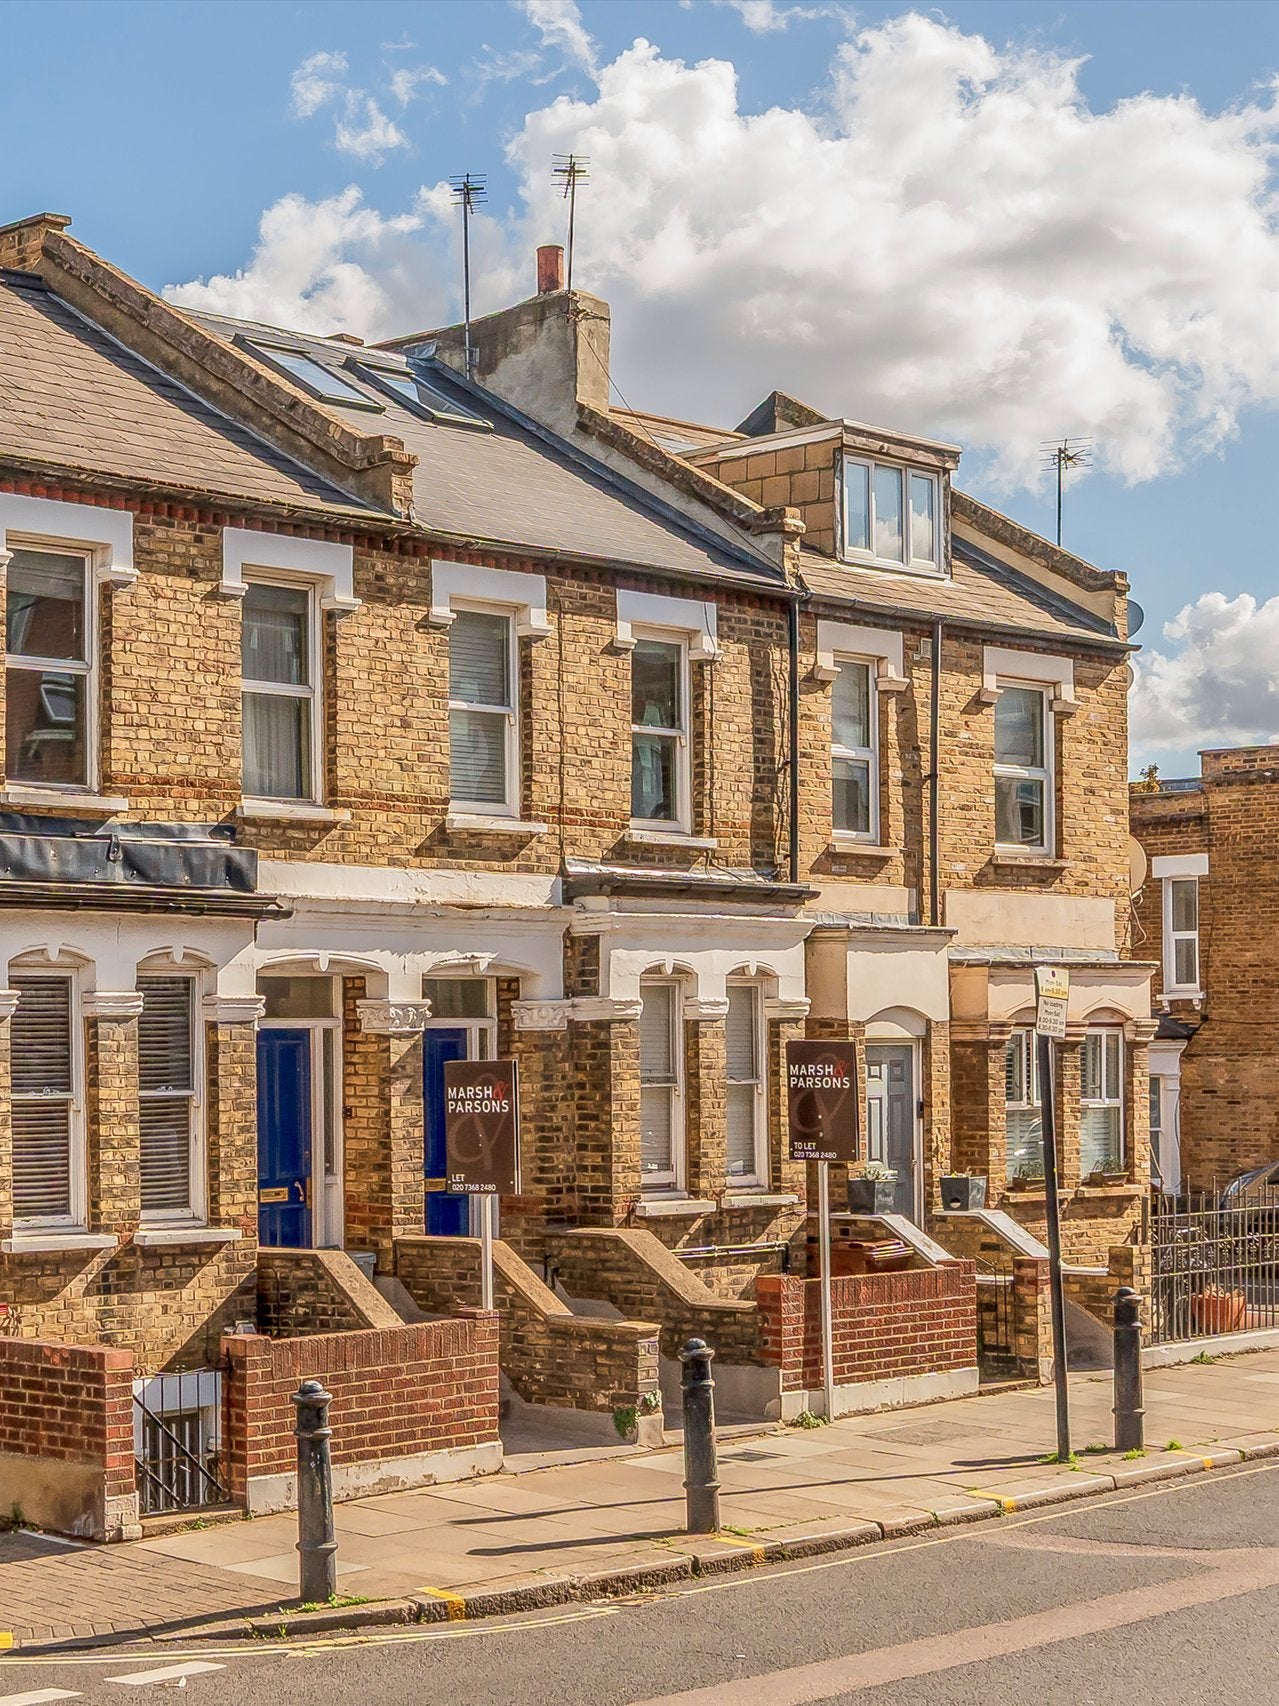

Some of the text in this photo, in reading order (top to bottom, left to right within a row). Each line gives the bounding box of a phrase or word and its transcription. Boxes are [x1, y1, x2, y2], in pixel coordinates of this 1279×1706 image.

[790, 1077, 850, 1088] PARSONS
[448, 1100, 509, 1113] PARSONS
[803, 1142, 816, 1150] LET
[820, 1151, 837, 1159] 2480
[451, 1174, 465, 1182] LET
[451, 1183, 496, 1191] 020 7368 2480
